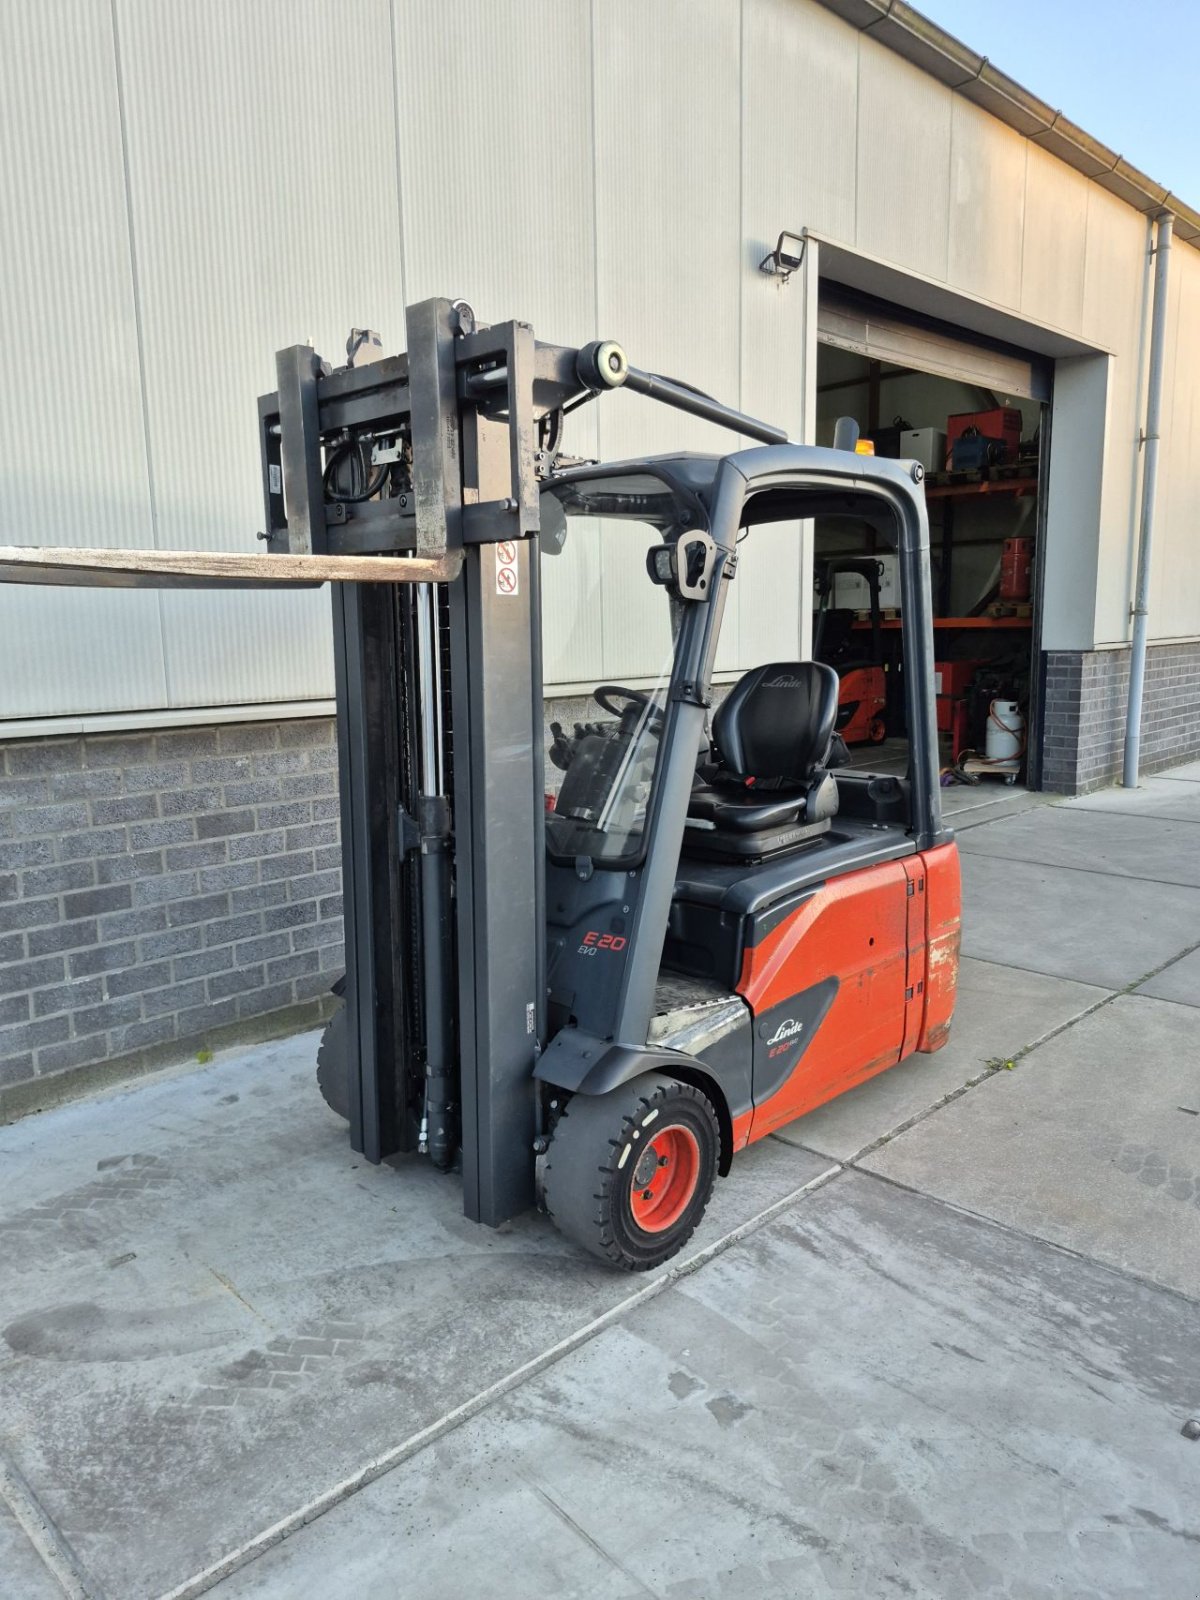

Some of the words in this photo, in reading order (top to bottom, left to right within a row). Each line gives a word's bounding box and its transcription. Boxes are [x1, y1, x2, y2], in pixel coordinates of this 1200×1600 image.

[761, 674, 802, 689] Linde
[577, 945, 598, 956] EVO
[766, 1018, 803, 1046] Linde
